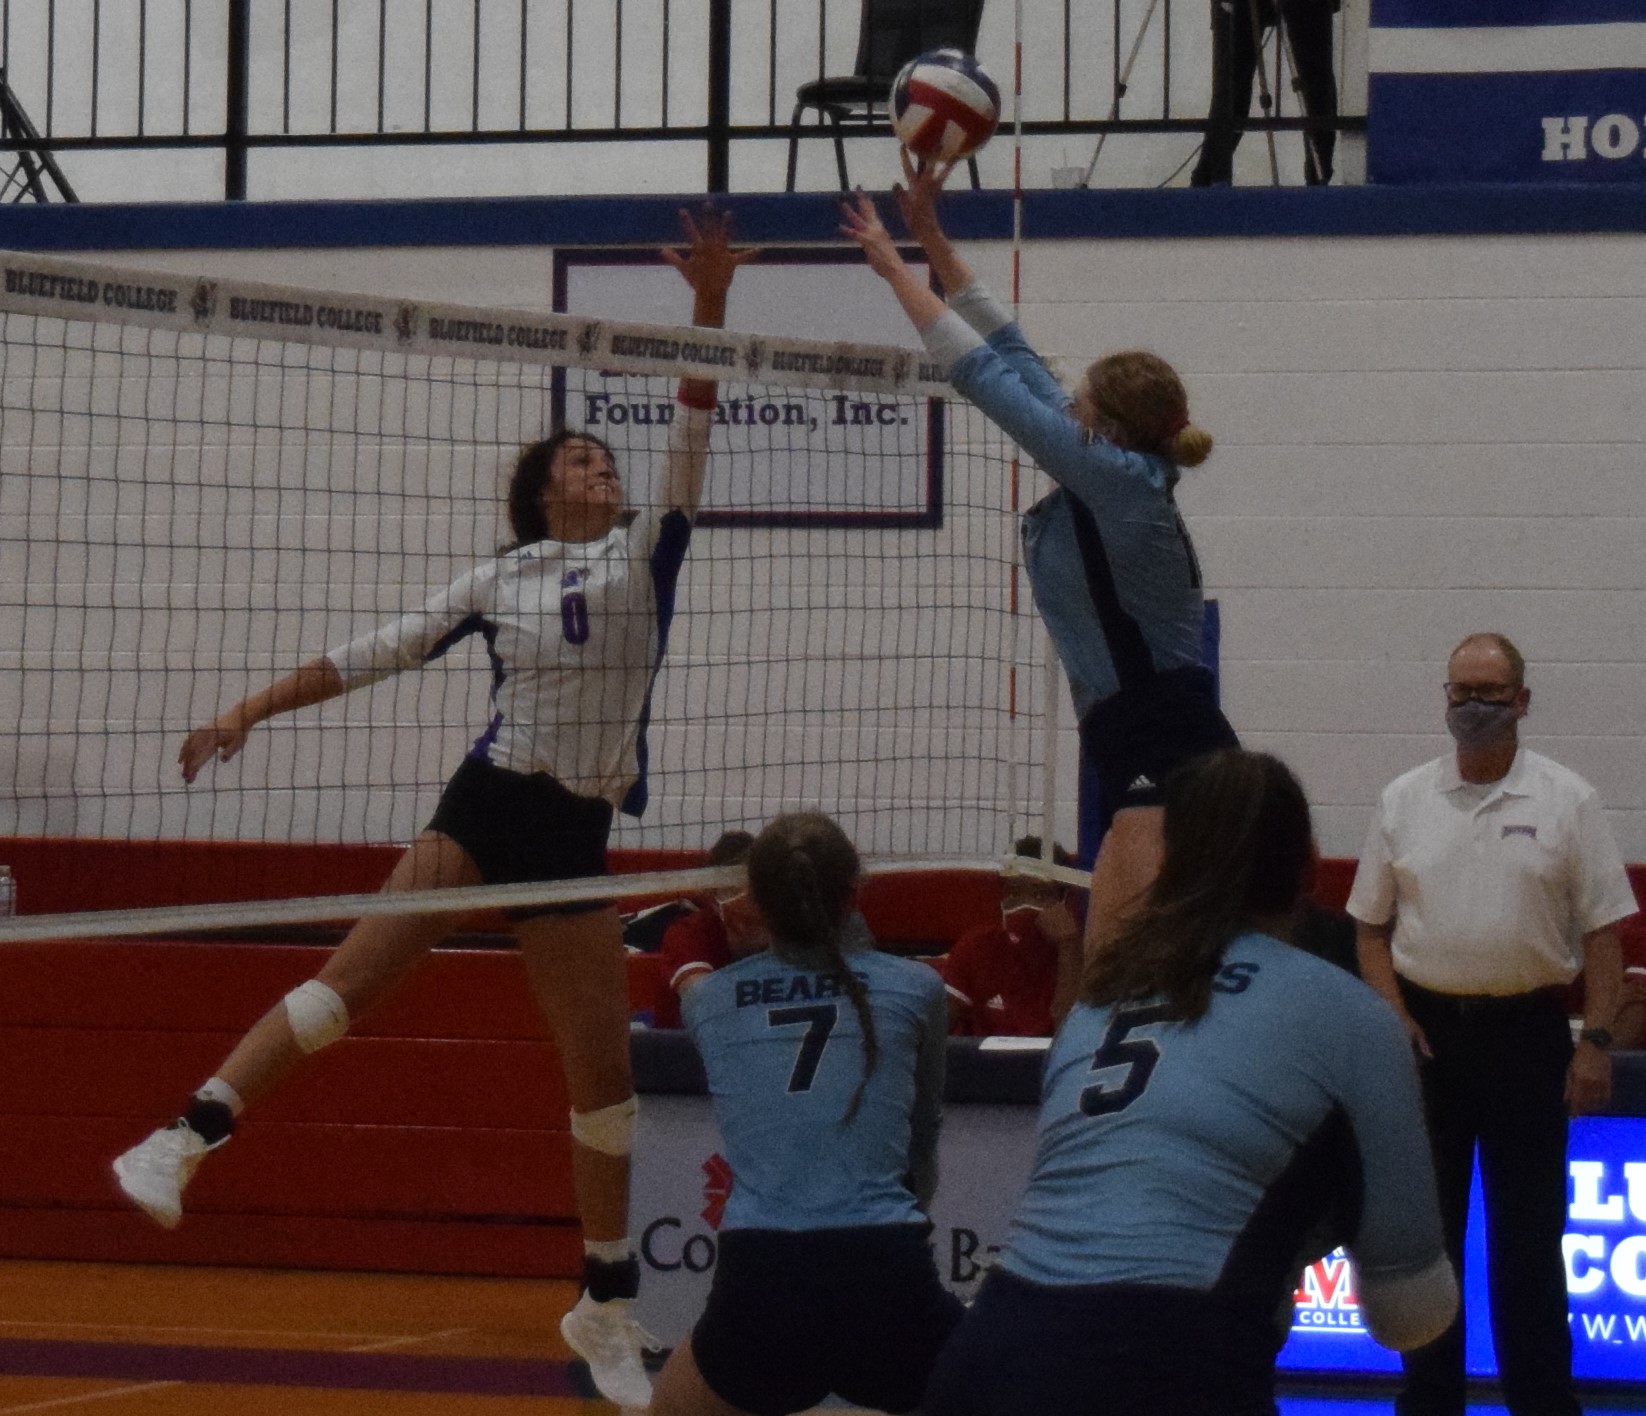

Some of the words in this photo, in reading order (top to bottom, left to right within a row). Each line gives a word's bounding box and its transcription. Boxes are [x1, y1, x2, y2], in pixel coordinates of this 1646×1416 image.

[1541, 113, 1646, 161] HO
[5, 268, 99, 303] BLUEFIELD
[103, 282, 178, 313] COLLEGE
[229, 297, 314, 326] BLUEFIELD
[316, 305, 384, 334] COLLEGE
[429, 317, 505, 345] BLUEFIELD
[507, 325, 568, 350] COLLEGE
[611, 334, 680, 360] BLUEFIELD
[681, 341, 736, 367] COLLEGE
[772, 350, 835, 374] BLUEFIELD
[585, 393, 818, 432] Founation,
[832, 395, 908, 426] Inc.
[561, 591, 590, 645] 0
[767, 1003, 839, 1094] 7
[1079, 1004, 1188, 1118] 5
[641, 1216, 716, 1273] Co
[950, 1226, 1000, 1283] B
[1299, 1311, 1359, 1326] COLLE
